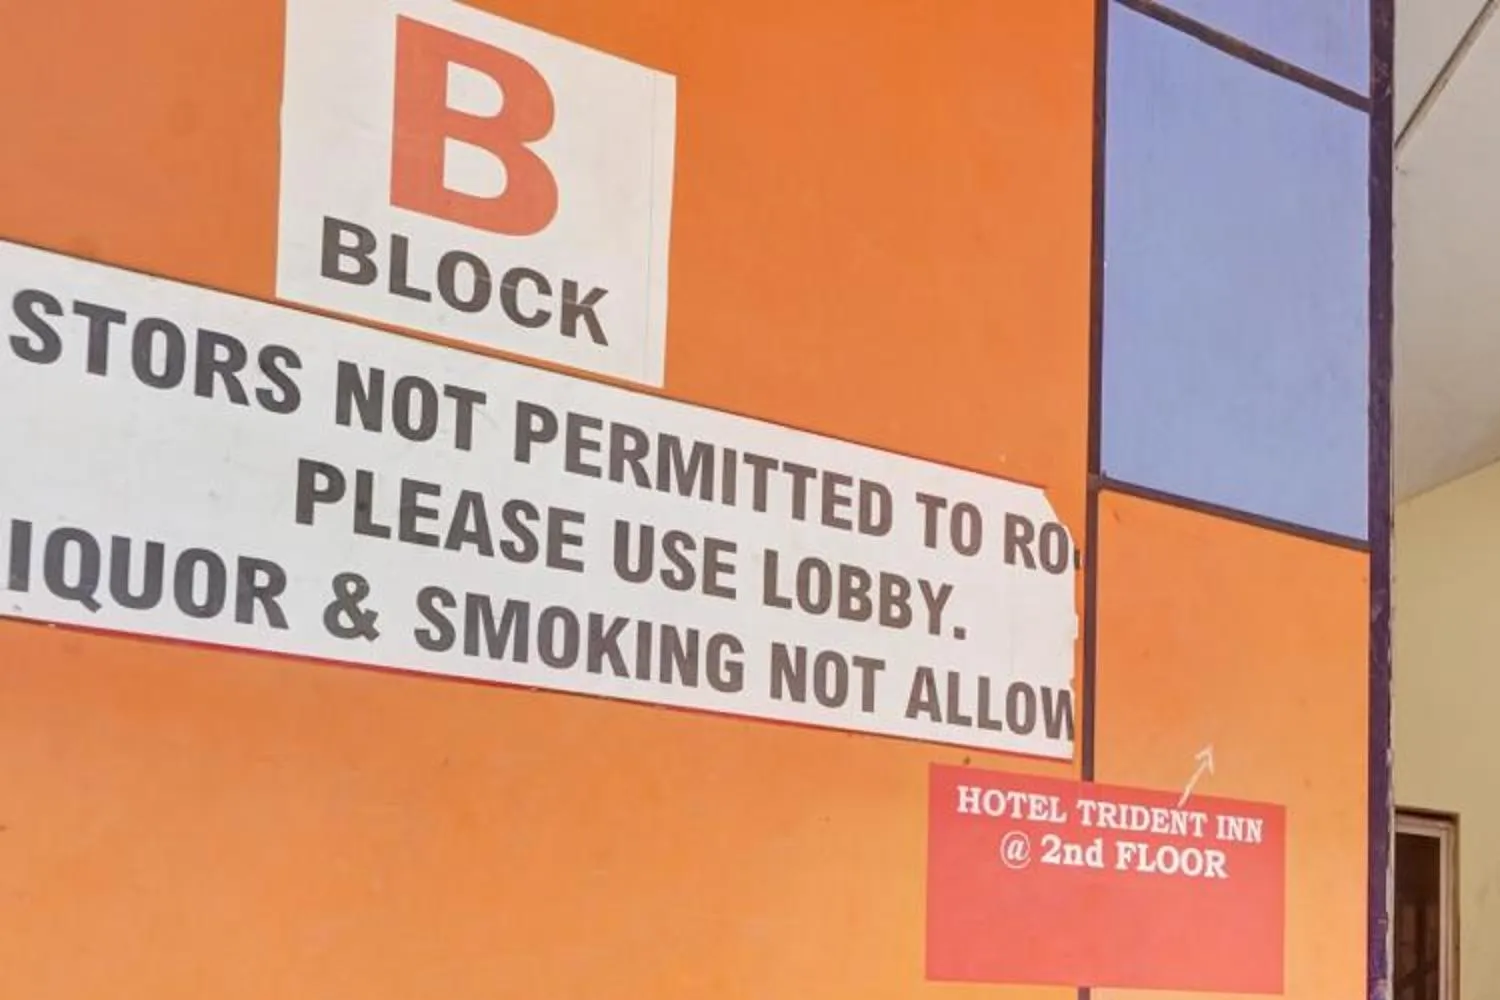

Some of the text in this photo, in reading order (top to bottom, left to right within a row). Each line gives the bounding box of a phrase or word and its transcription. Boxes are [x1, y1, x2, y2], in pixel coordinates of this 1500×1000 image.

[389, 13, 559, 237] B
[319, 214, 609, 347] BLOCK
[9, 288, 1080, 575] STORS NOT PERMITTED TO RO
[7, 517, 289, 630] IQUOR
[322, 571, 380, 642] &
[413, 584, 745, 695] SMOKING
[768, 641, 886, 714] NOT
[294, 457, 967, 641] PLEASE USE LOBBY.
[956, 784, 1264, 844] HOTEL TRIDENT INN
[1000, 830, 1229, 880] @ 2nd FLOOR
